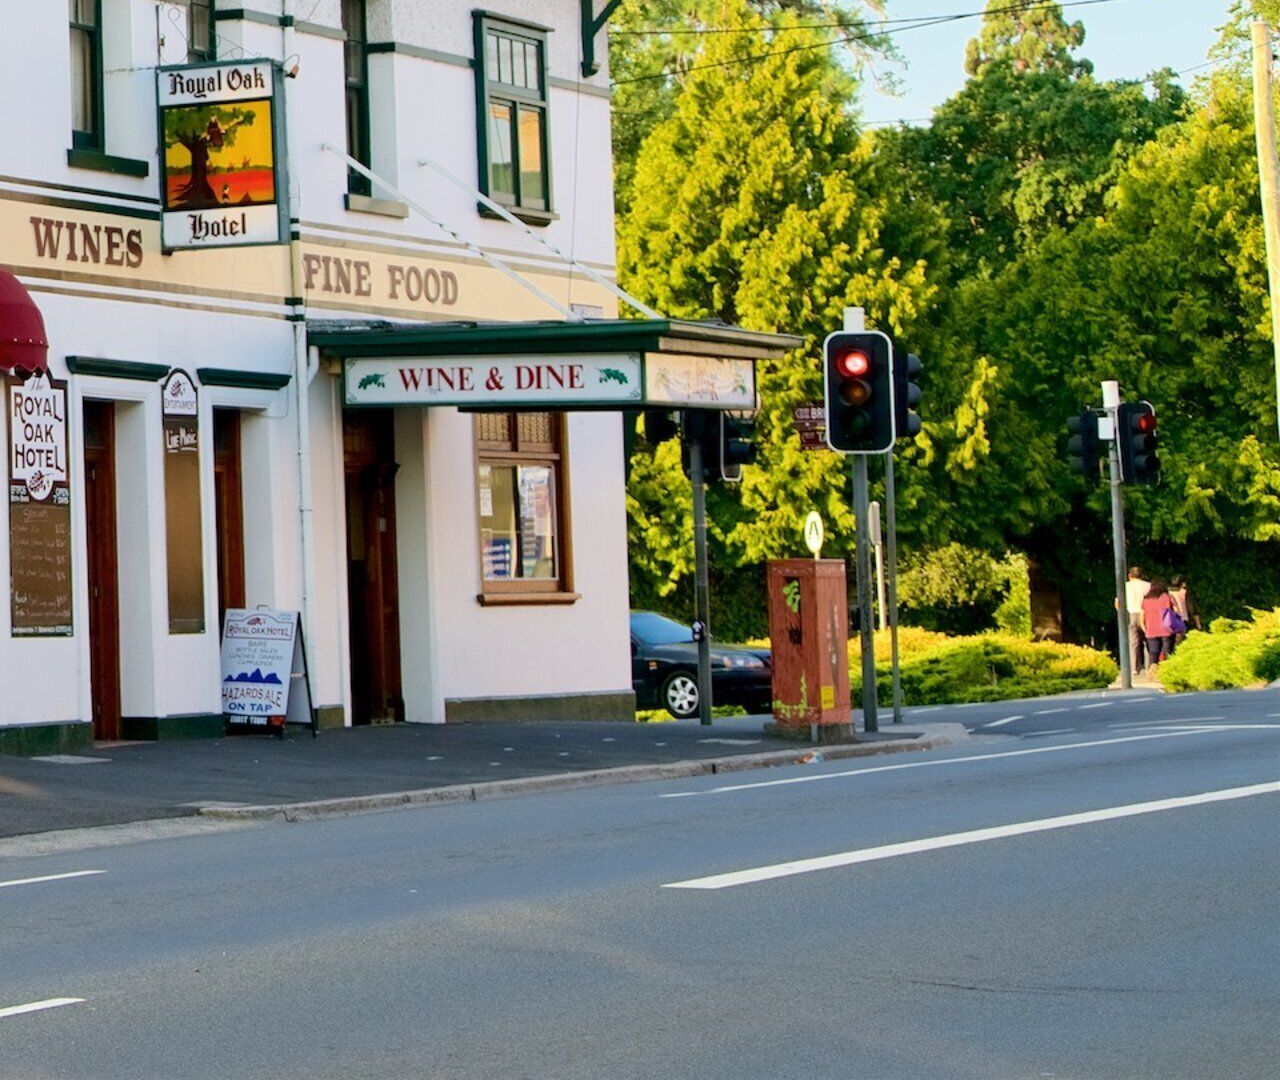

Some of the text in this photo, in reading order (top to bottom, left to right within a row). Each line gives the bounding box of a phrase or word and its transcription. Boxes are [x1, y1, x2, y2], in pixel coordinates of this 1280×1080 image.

[168, 67, 265, 98] Royal Oak
[30, 216, 143, 268] WINES
[188, 212, 246, 243] Hotel
[303, 253, 458, 305] FINE FOOD
[398, 364, 585, 392] WINE & DINE
[14, 391, 63, 424] ROYAL
[24, 423, 54, 443] OAK
[15, 443, 65, 473] HOTEL
[222, 687, 283, 707] HAZARDS ALE
[228, 702, 273, 712] ON TAP
